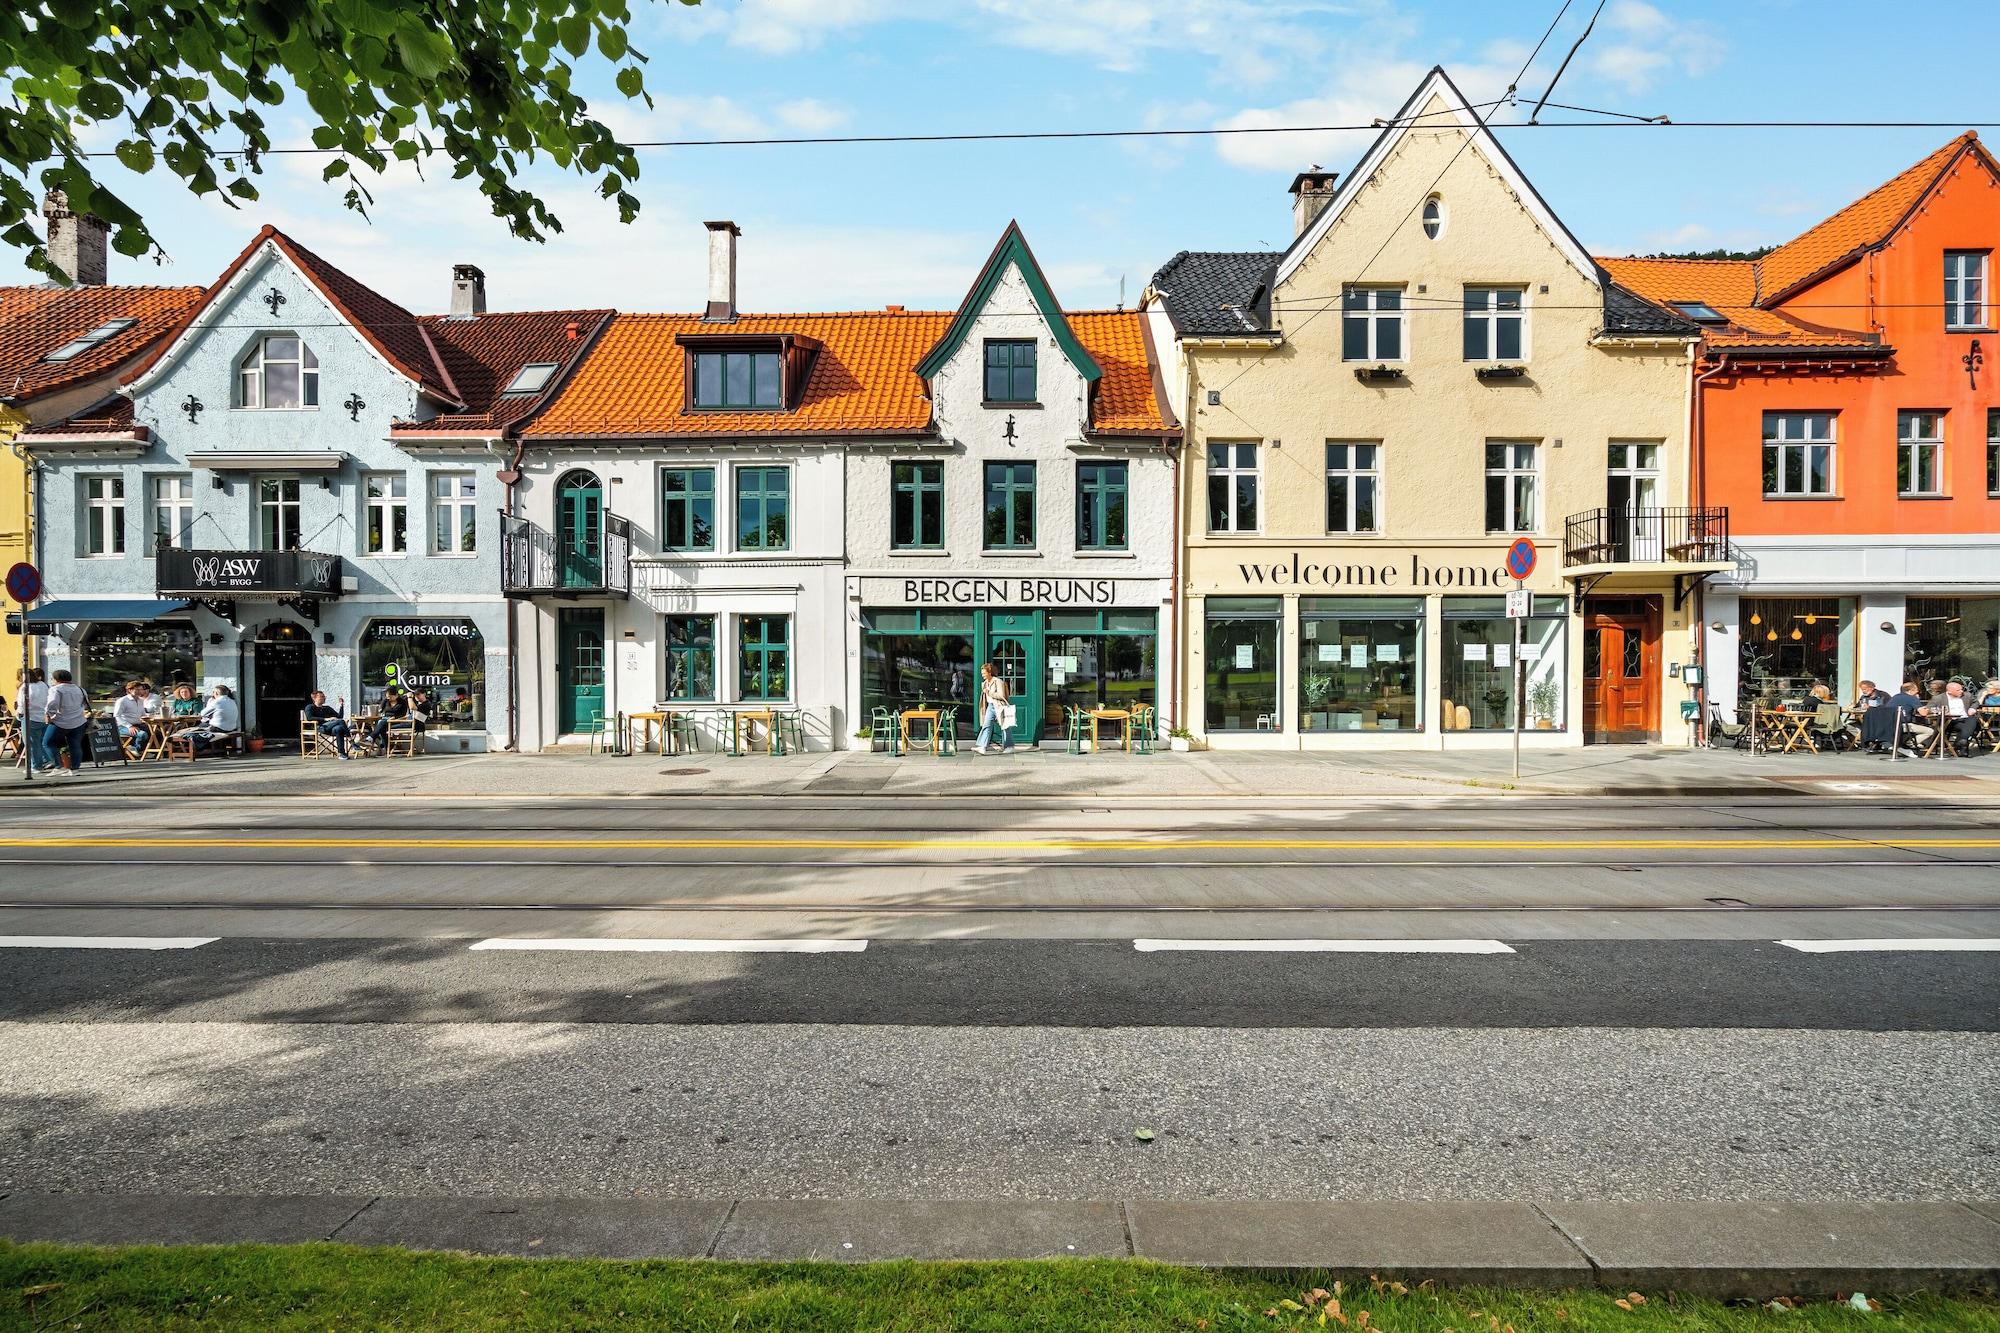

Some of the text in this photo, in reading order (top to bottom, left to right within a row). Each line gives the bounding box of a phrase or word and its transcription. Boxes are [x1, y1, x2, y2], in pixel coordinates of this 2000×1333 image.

[220, 559, 261, 576] ASW
[1237, 552, 1509, 588] welcome home
[904, 580, 1115, 604] BERGEN BRUNSJ
[378, 625, 468, 636] FRISØRSALONG
[385, 662, 451, 693] Karma
